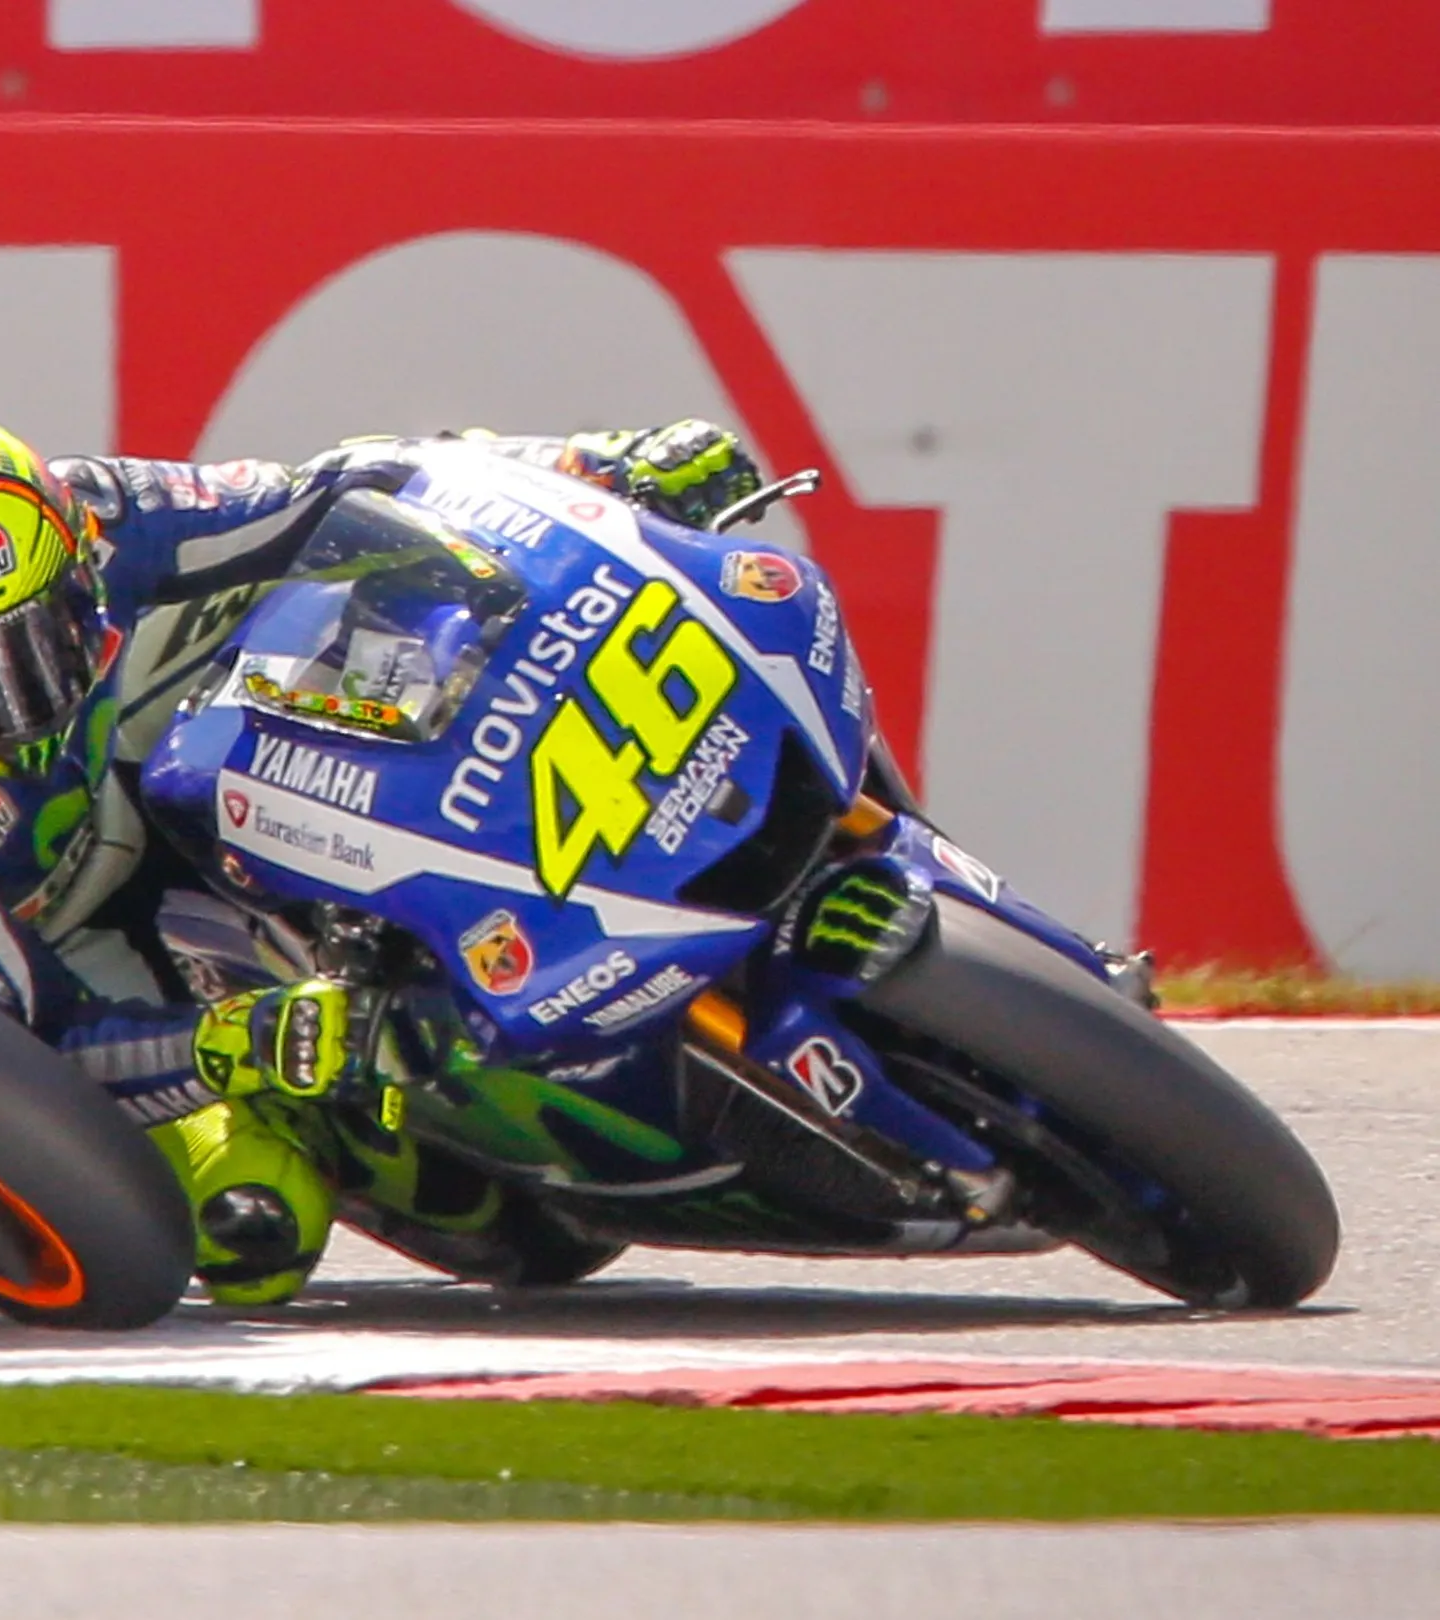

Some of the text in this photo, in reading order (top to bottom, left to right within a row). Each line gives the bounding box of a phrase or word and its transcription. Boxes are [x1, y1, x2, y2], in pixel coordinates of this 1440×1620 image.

[439, 561, 635, 832] movistar
[248, 733, 378, 815] YAMAHA
[528, 577, 738, 899] 46
[331, 832, 375, 871] Bank
[528, 951, 637, 1026] ENEOS
